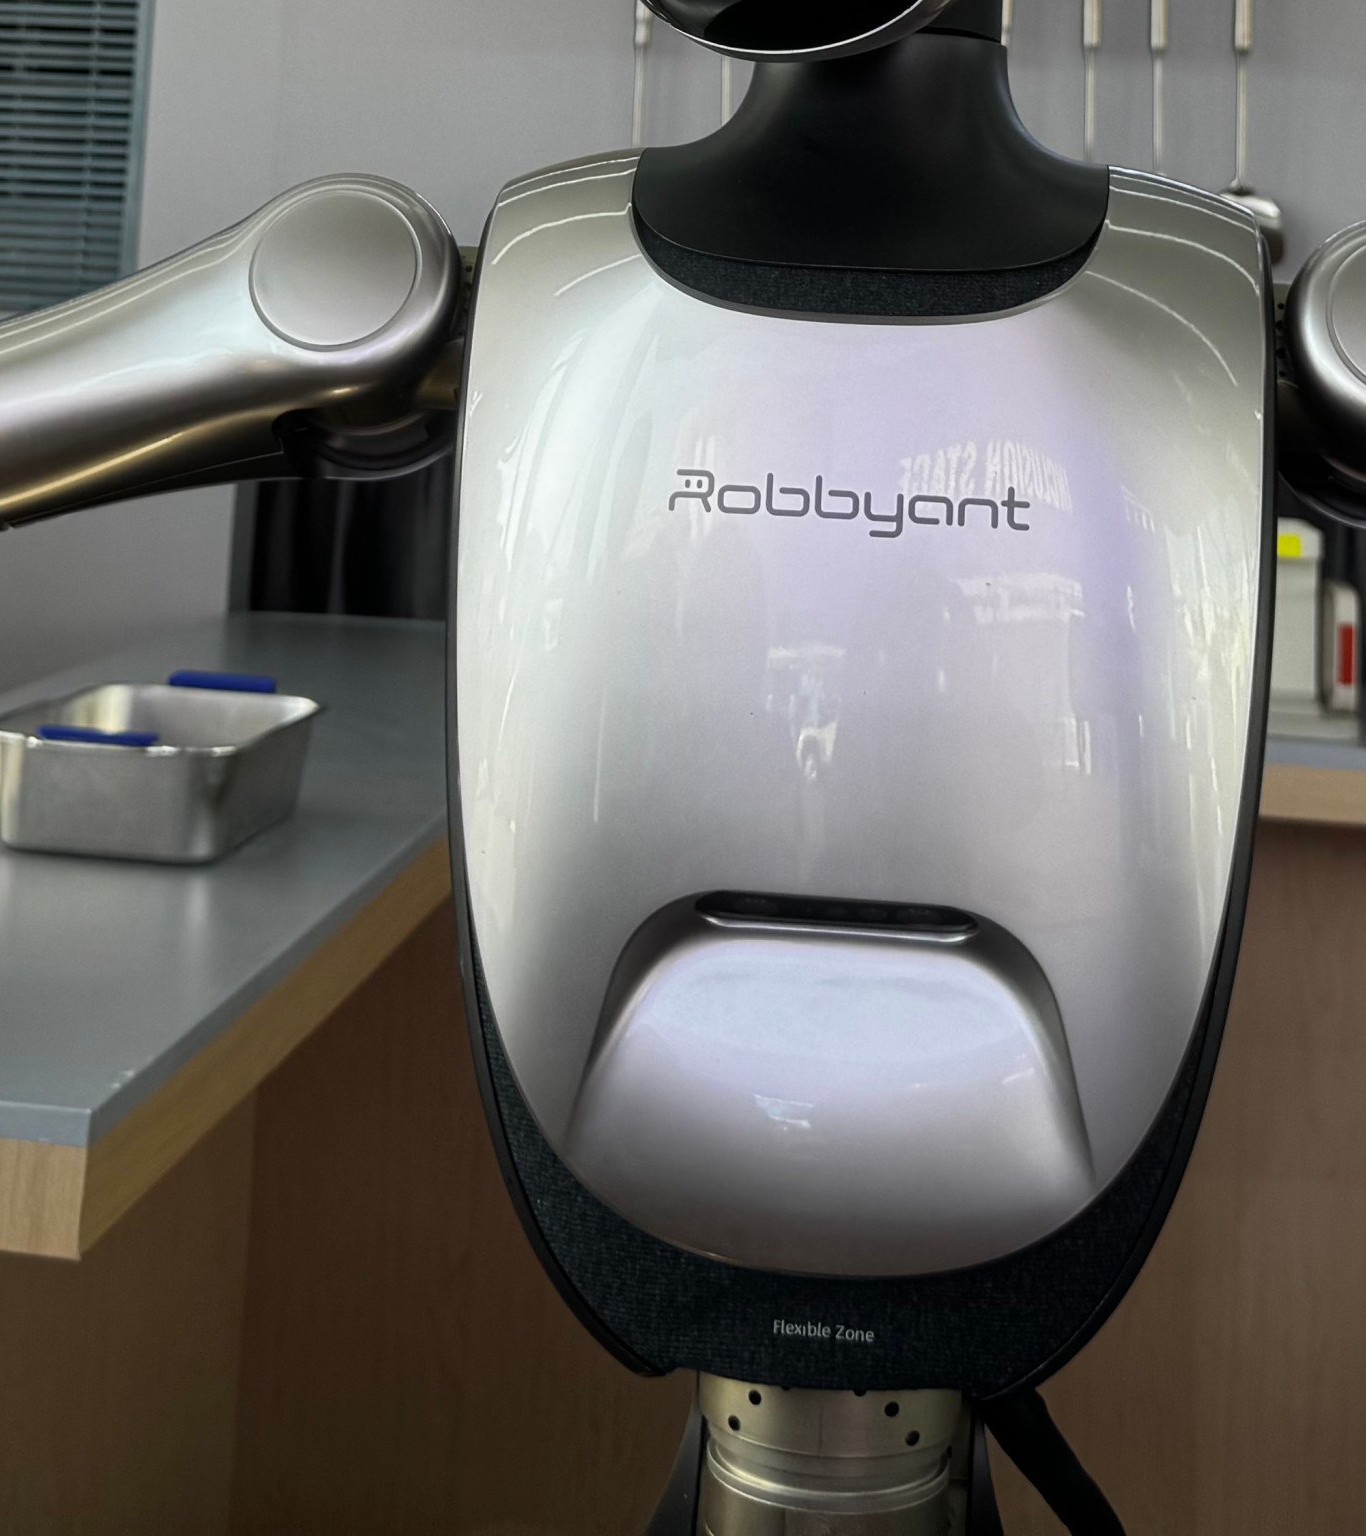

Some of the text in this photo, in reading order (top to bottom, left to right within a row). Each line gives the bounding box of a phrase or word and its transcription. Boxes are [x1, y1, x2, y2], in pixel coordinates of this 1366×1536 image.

[667, 468, 1032, 539] Robbyant
[773, 1318, 875, 1343] Flexible Zone
